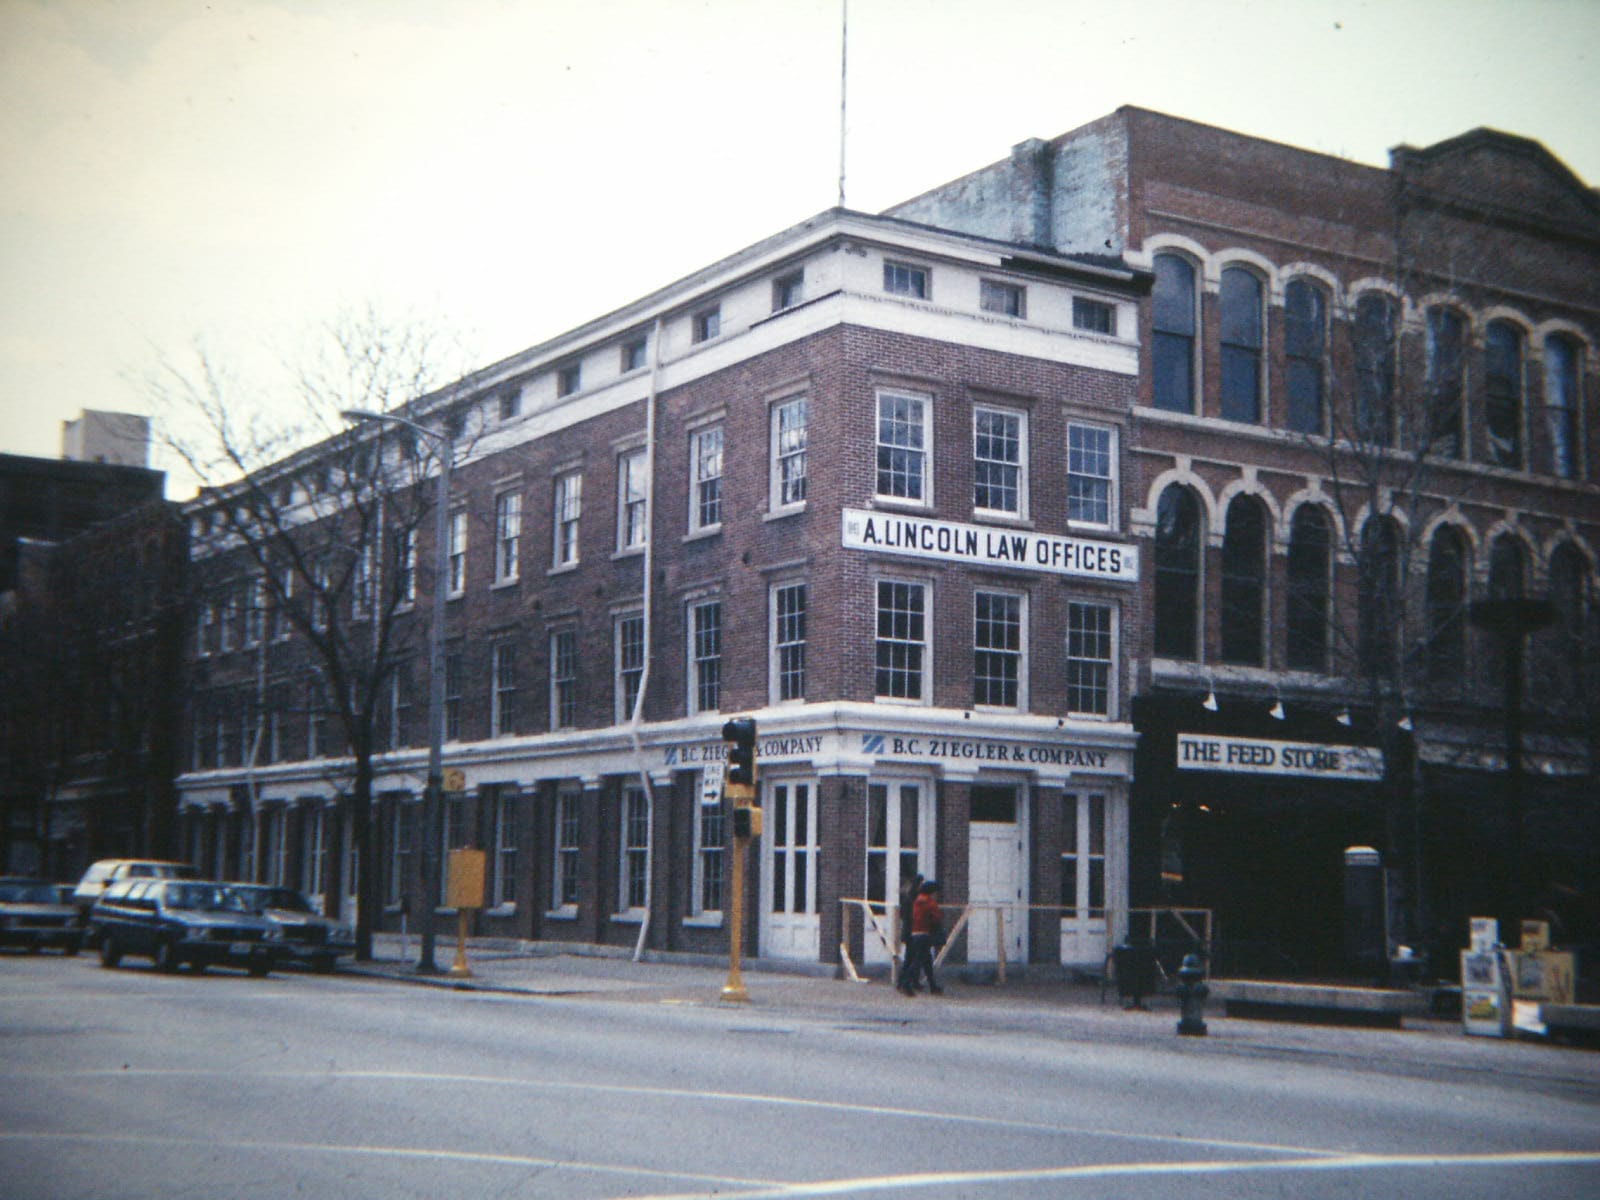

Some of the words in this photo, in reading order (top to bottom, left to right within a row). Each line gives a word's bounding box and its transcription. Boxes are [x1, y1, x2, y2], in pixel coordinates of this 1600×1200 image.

[986, 532, 1027, 562] LAW
[1036, 539, 1121, 574] OFFICES
[702, 744, 730, 762] ZIEG
[764, 736, 824, 757] COMPANY
[893, 738, 922, 756] B.C.
[930, 740, 1008, 762] ZIEGLER
[1013, 749, 1025, 762] &
[1029, 747, 1108, 768] COMPANY
[1181, 740, 1220, 762] THE
[1226, 743, 1276, 766] FEED
[1281, 747, 1340, 770] STORE
